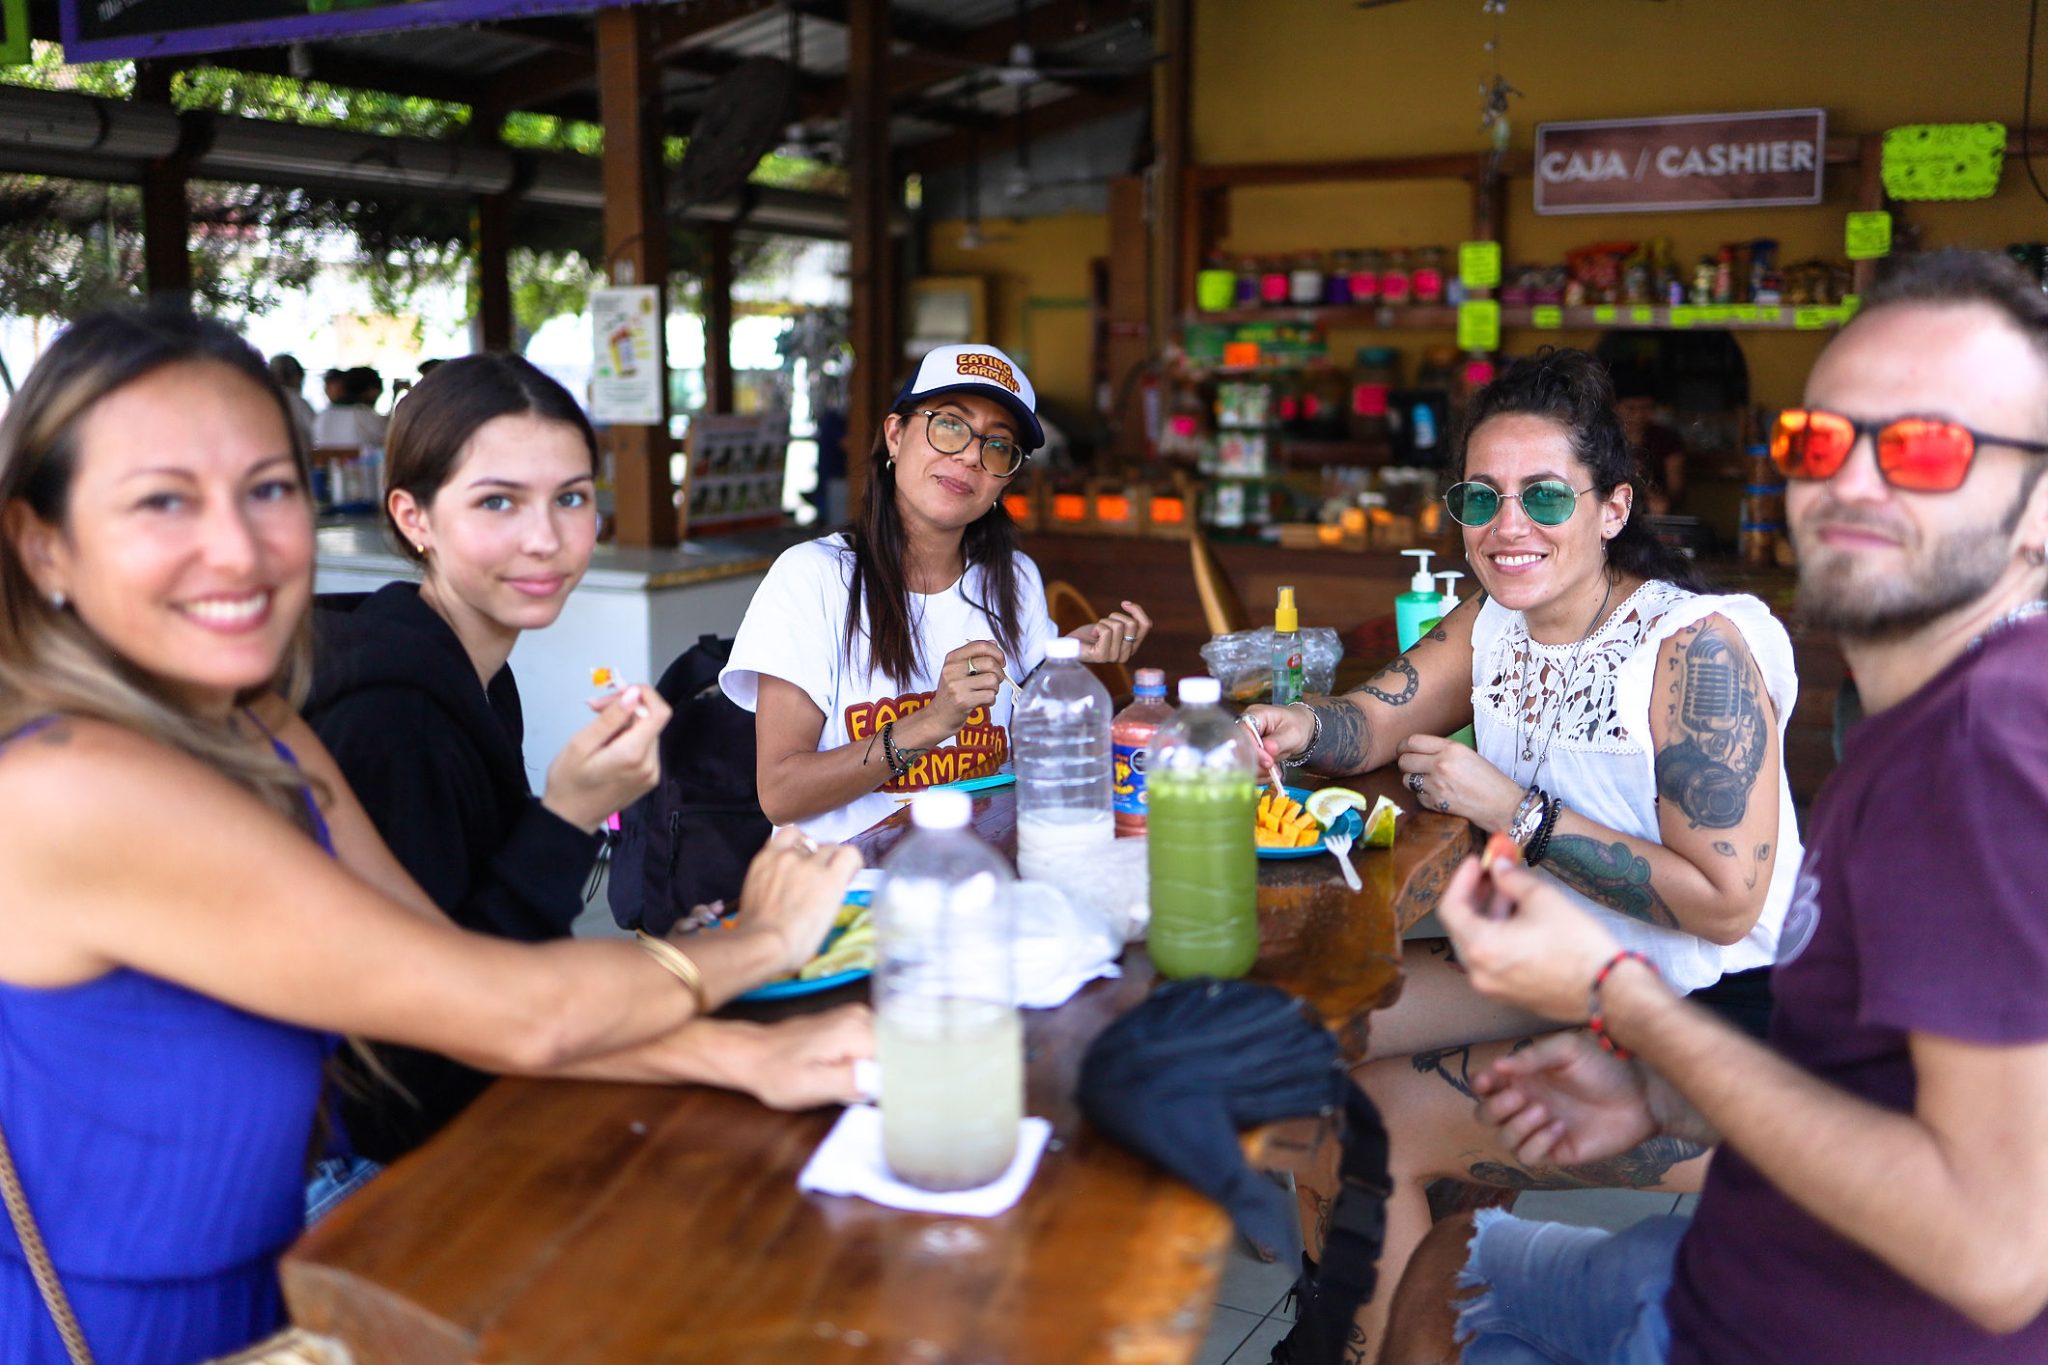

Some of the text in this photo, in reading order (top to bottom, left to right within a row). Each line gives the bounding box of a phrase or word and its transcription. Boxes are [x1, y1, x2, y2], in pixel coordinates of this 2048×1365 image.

[1539, 140, 1815, 184] CAJA / CASHIER
[958, 354, 1011, 375] EATING
[960, 727, 1003, 754] with
